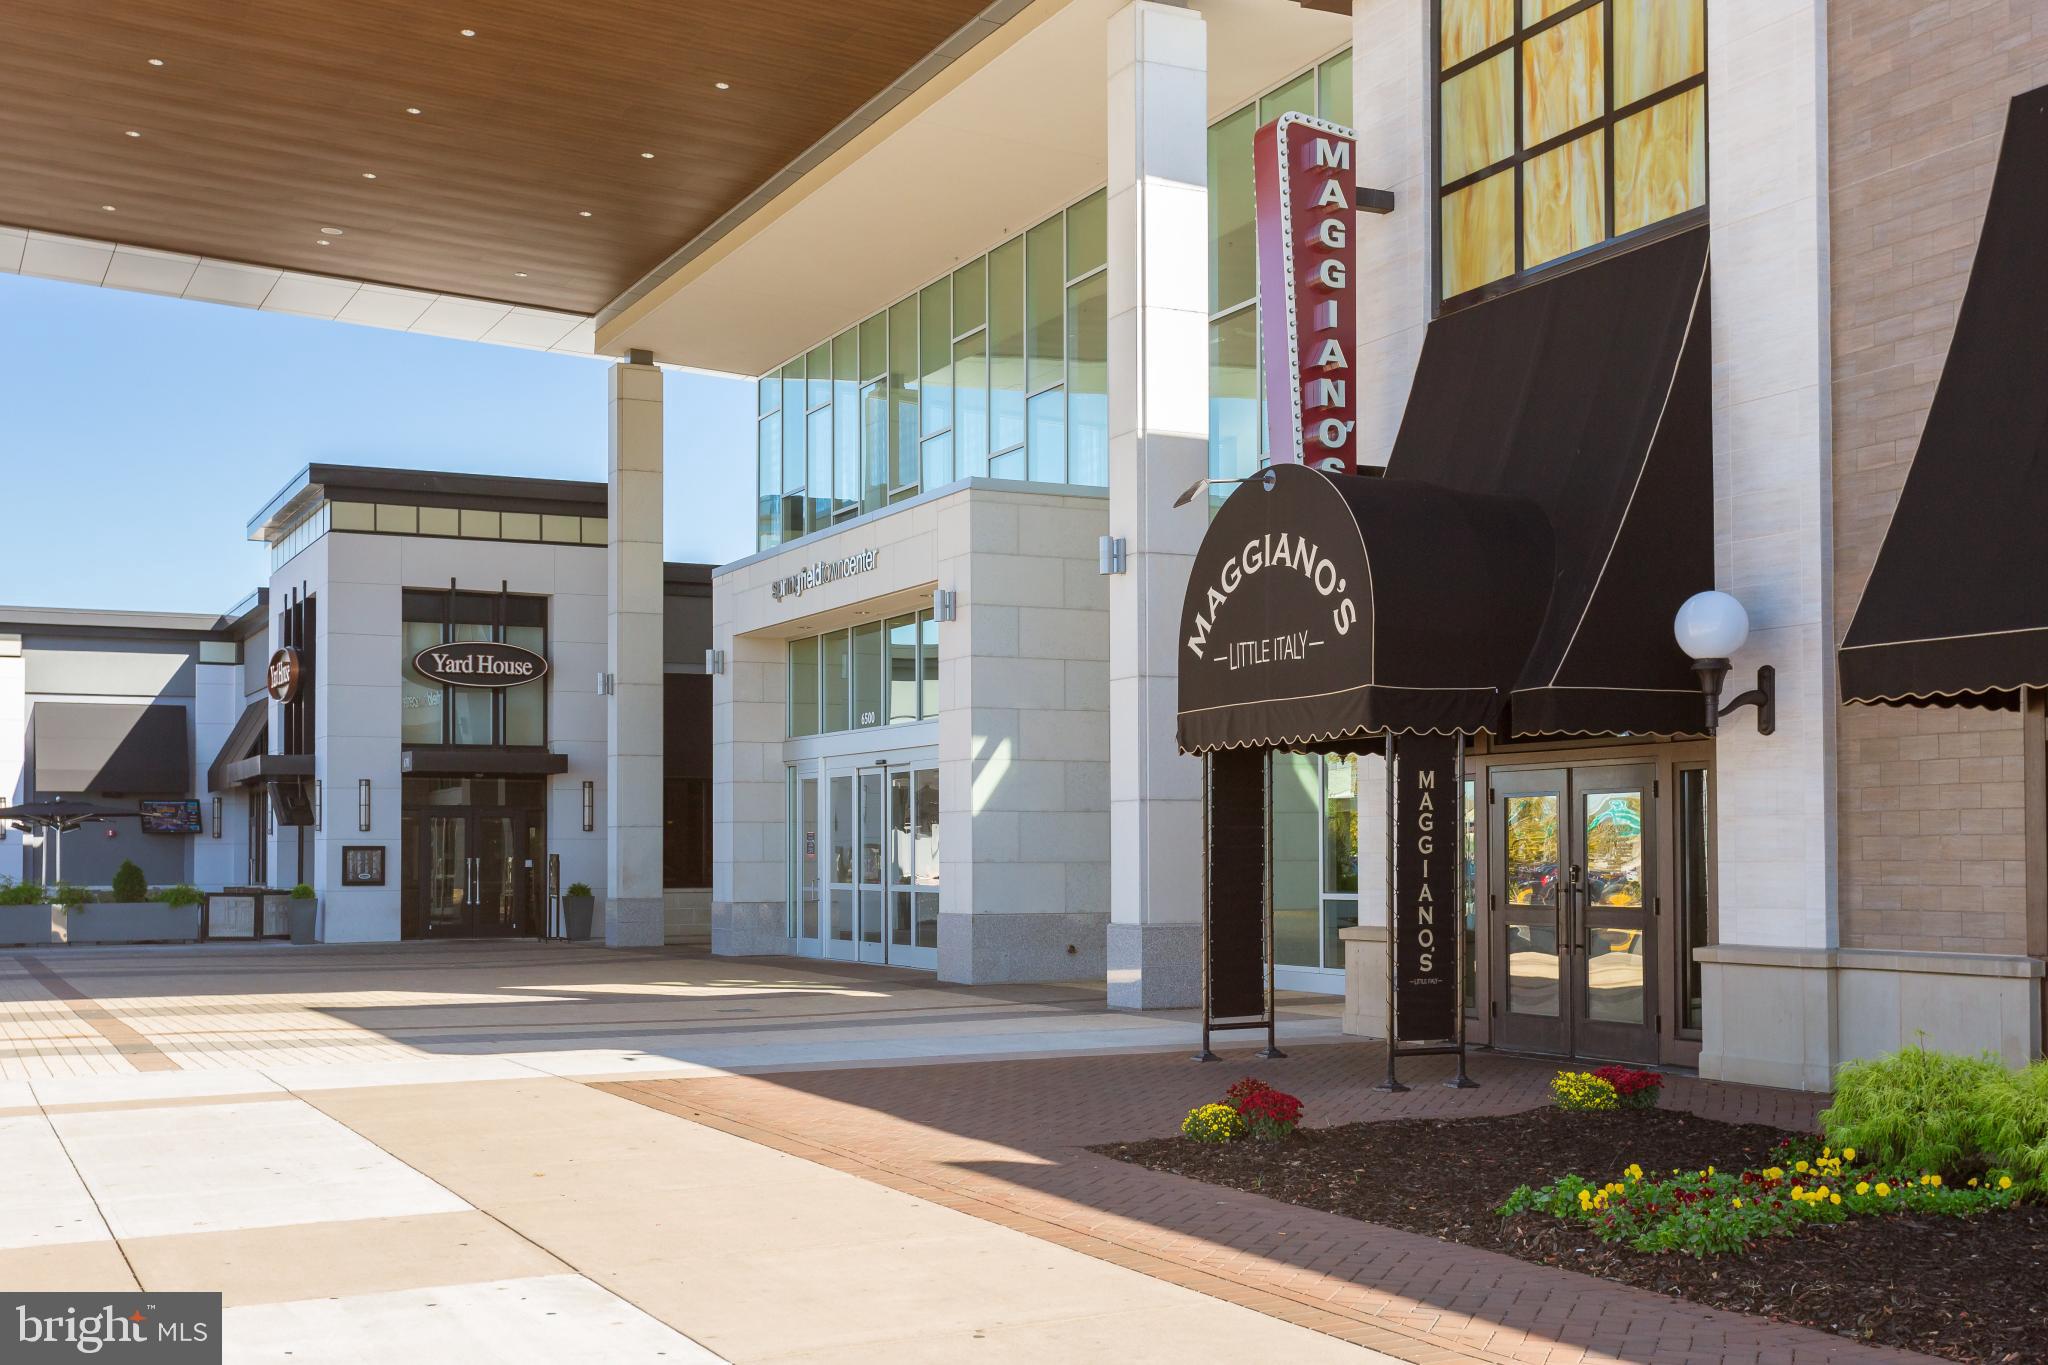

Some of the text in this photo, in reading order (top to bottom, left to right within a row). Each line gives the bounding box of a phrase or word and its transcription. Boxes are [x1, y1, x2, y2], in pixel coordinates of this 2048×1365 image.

[1187, 532, 1357, 659] MAGGIANO'S
[431, 653, 533, 676] Yard House
[1229, 629, 1308, 671] LITTLE ITALY
[861, 711, 876, 725] 6500
[1418, 770, 1435, 972] MAGGIANO'S
